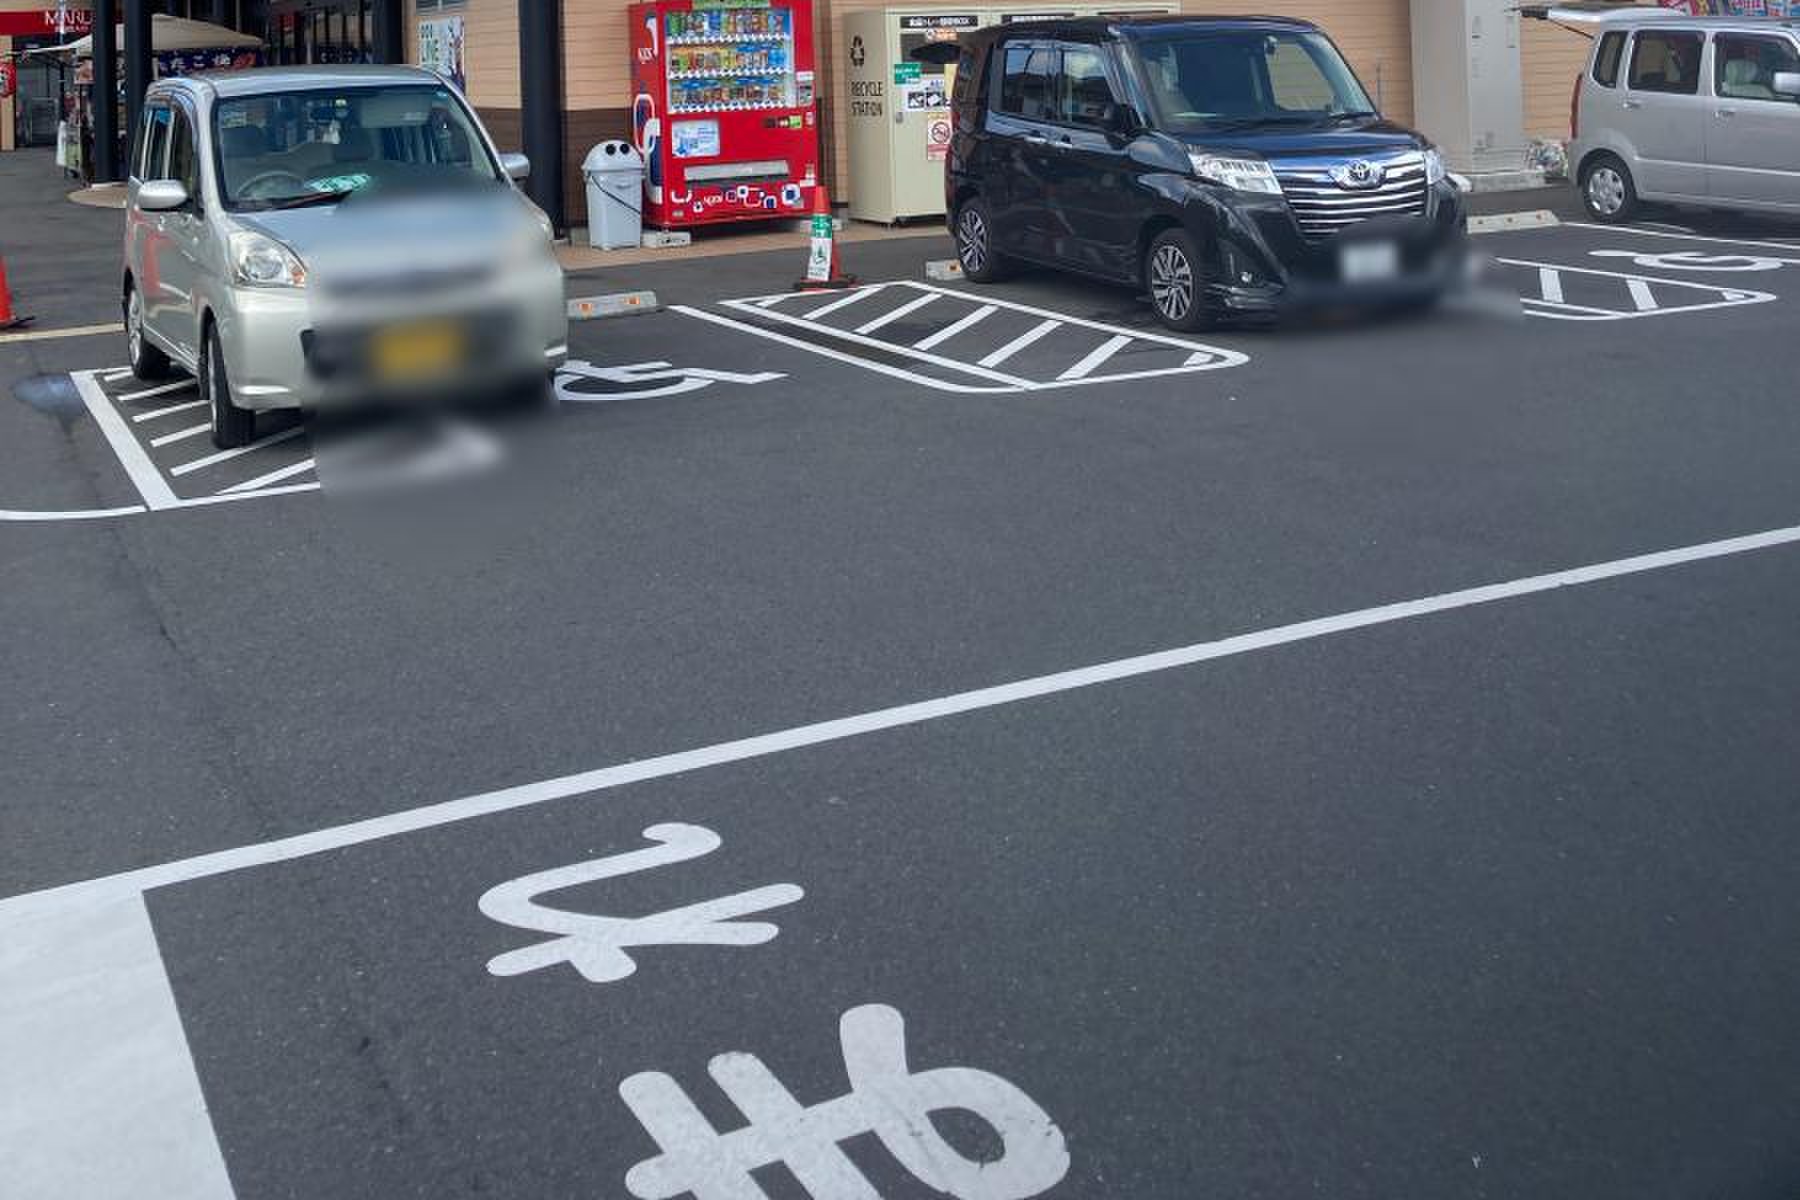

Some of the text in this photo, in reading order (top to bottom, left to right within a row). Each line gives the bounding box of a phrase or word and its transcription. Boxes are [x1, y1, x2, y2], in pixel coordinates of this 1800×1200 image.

[45, 10, 94, 26] MARU
[850, 81, 883, 97] RECYCLE
[850, 101, 883, 117] STATION
